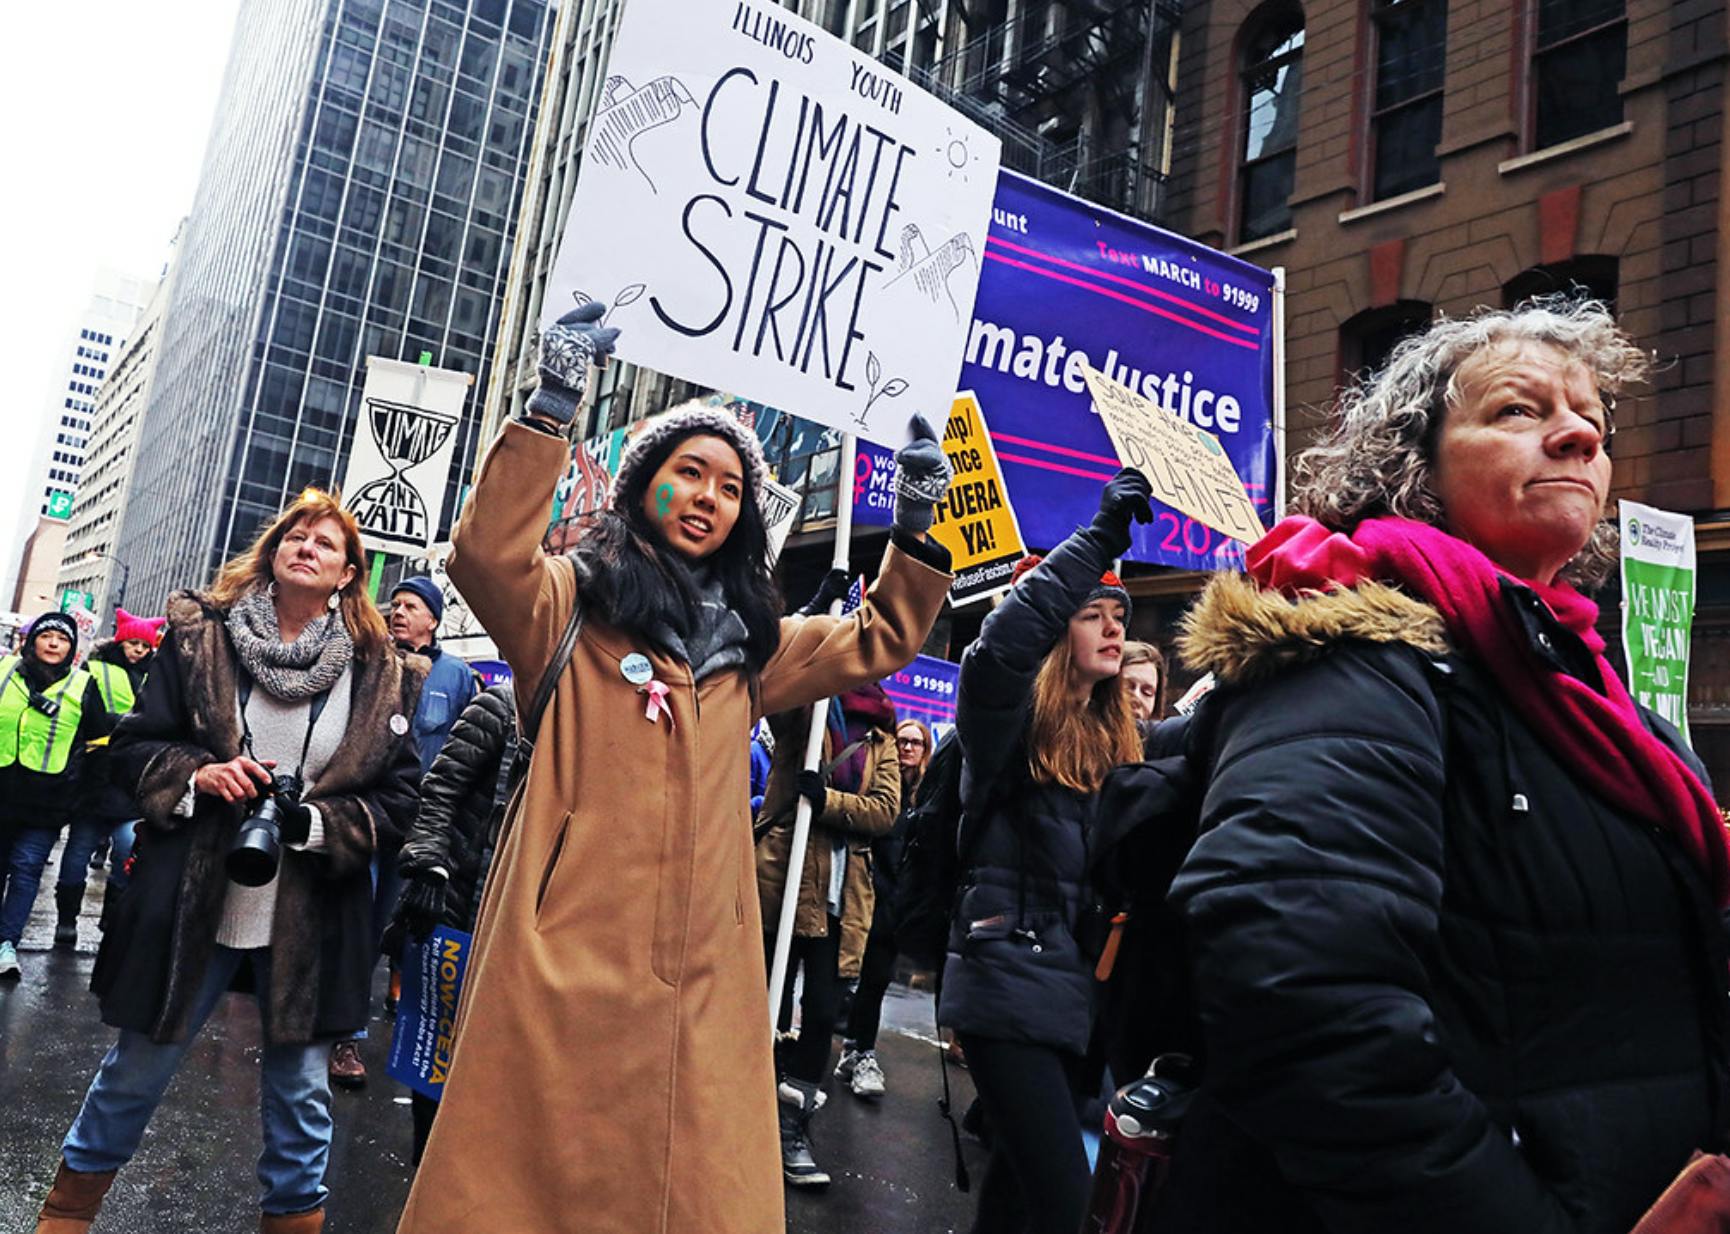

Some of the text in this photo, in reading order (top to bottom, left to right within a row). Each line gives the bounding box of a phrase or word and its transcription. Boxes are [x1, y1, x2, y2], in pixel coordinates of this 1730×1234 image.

[732, 1, 815, 65] ILLINOIS
[851, 60, 902, 115] YOUTH
[701, 66, 917, 261] CLIMATE
[650, 194, 884, 391] STRIKE
[1096, 240, 1259, 313] Text MARCH to 91999
[1091, 349, 1241, 433] Justice
[372, 407, 451, 463] CLIMATE
[349, 498, 423, 537] WAIT.
[933, 478, 1002, 525] FUERA
[1119, 431, 1262, 540] PLANET
[959, 518, 997, 556] YA!
[895, 671, 954, 695] to 91999
[417, 1015, 426, 1041] Jobs
[419, 936, 442, 1079] Tell Springfield to pass the
[428, 939, 461, 1084] NOW-CEJA
